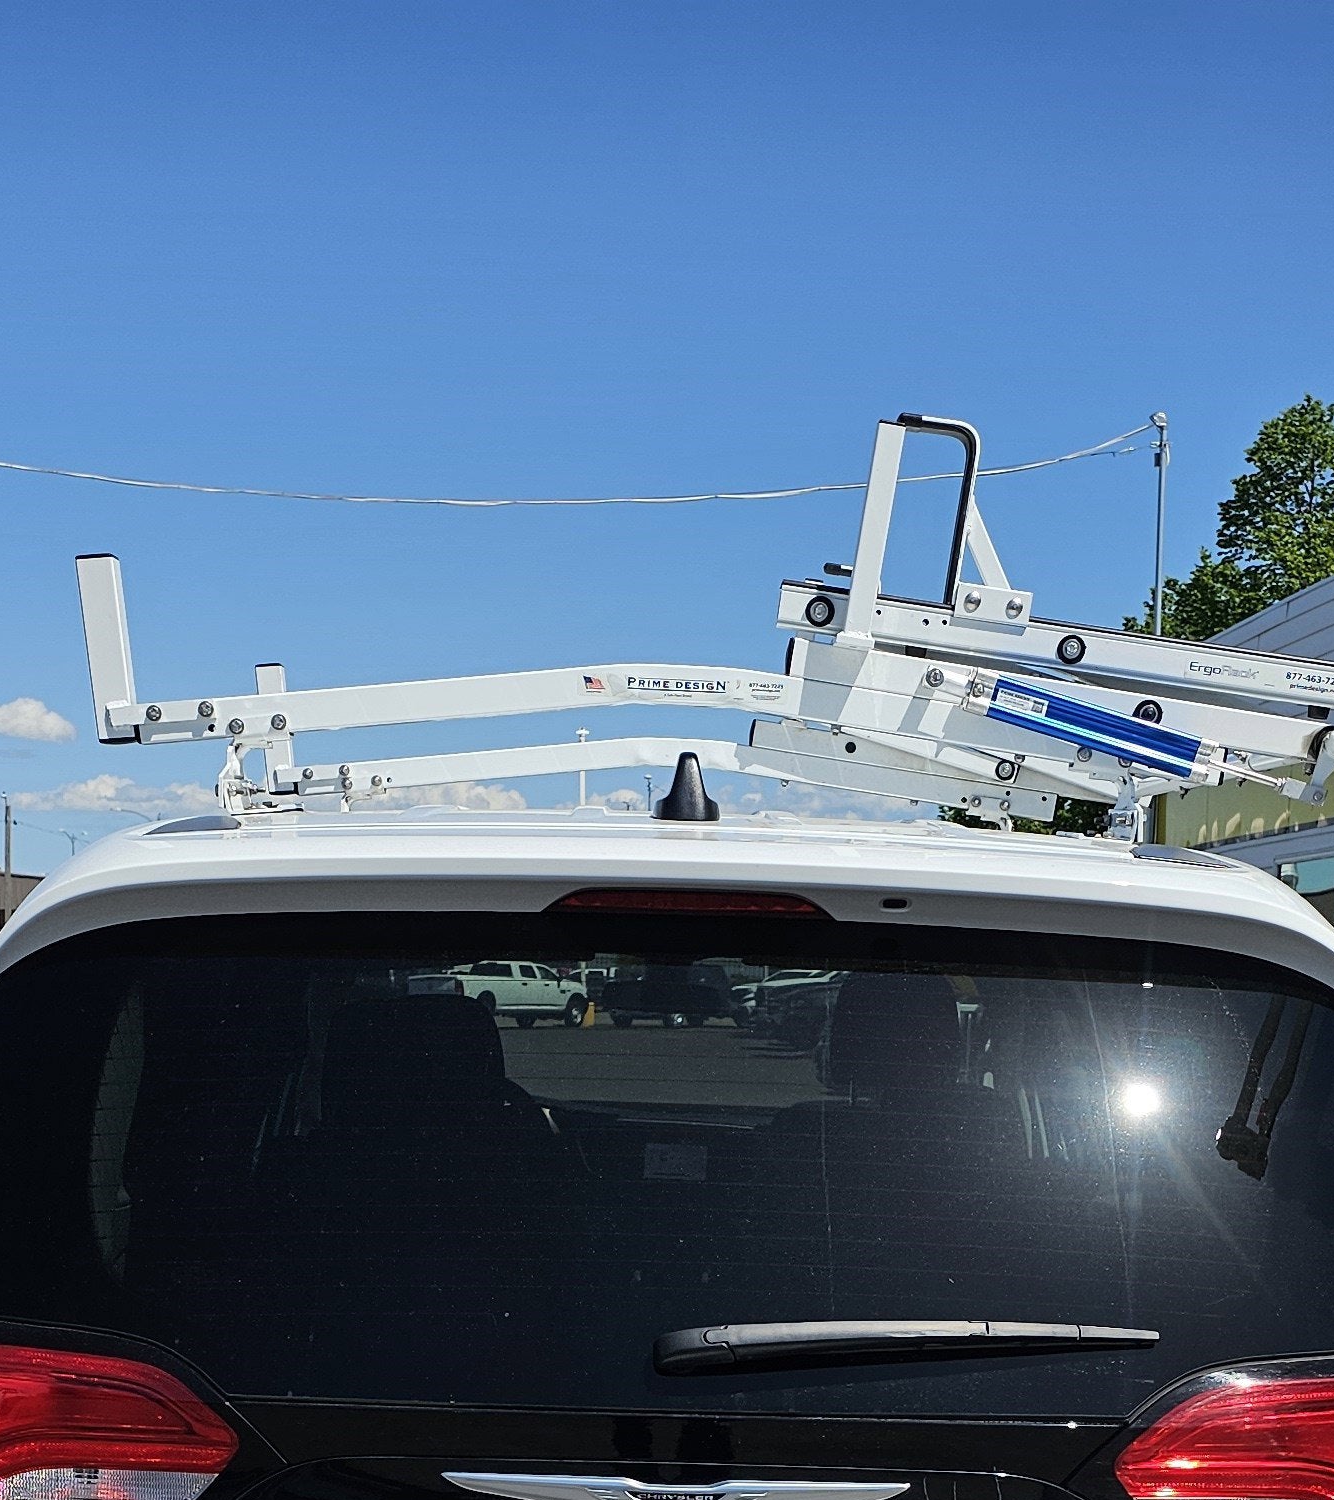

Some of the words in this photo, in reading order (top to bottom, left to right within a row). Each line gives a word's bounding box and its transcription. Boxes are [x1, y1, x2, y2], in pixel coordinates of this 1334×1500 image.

[627, 676, 670, 689] PRIME
[675, 680, 727, 691] DESIGN
[637, 1493, 714, 1500] CHRYSLER
